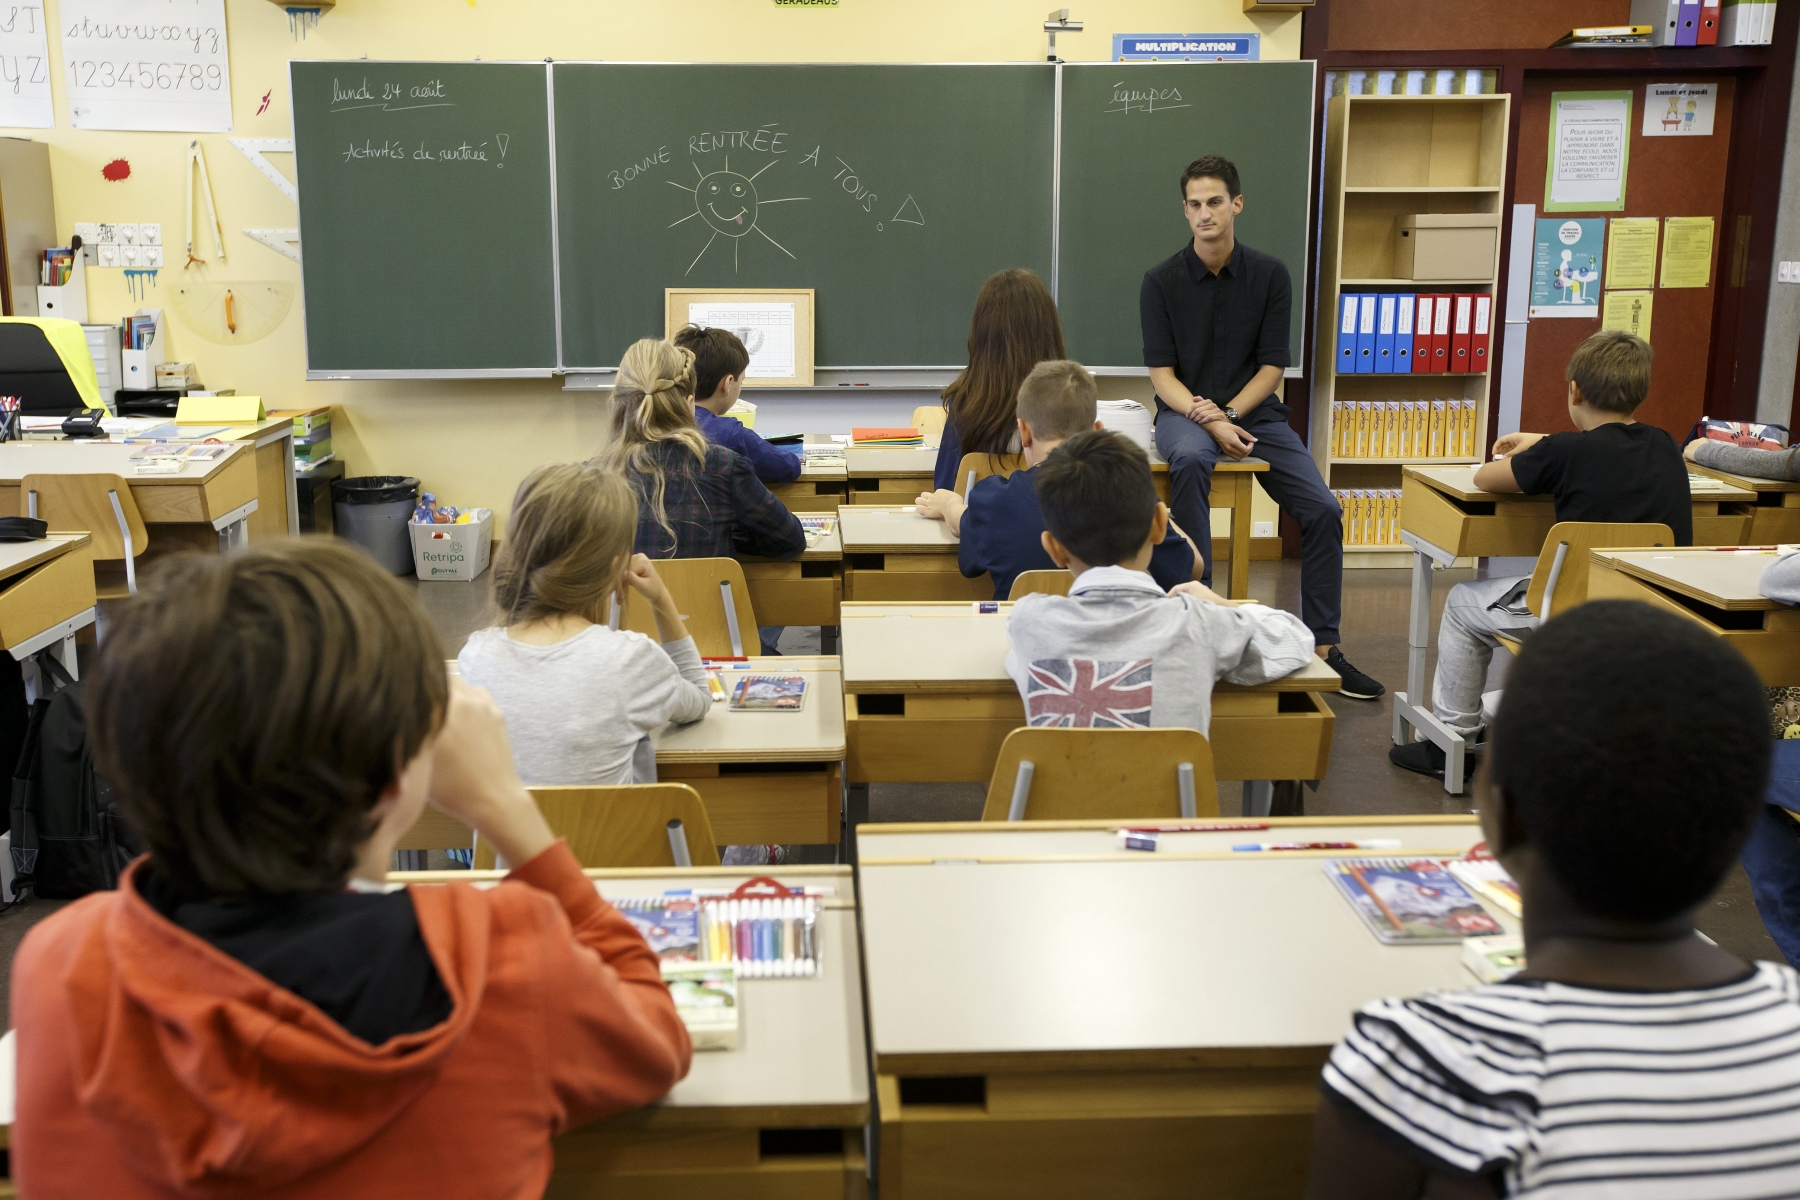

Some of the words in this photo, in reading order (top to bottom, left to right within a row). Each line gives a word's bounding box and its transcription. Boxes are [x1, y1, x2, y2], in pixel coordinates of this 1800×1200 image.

[1135, 43, 1236, 52] MULTIPLICATION
[332, 77, 374, 104] lundi
[382, 83, 402, 100] 24
[410, 80, 446, 98] août
[1109, 82, 1182, 115] équipes
[342, 139, 404, 162] Activités
[413, 142, 435, 160] de
[439, 142, 488, 162] rentrée
[608, 146, 670, 189] BONNE
[688, 123, 788, 155] RENTRÉE
[798, 146, 820, 167] A
[834, 156, 877, 212] TOUS
[1731, 431, 1744, 441] PEPE
[1747, 431, 1765, 443] JEANS
[423, 552, 464, 563] Retripa
